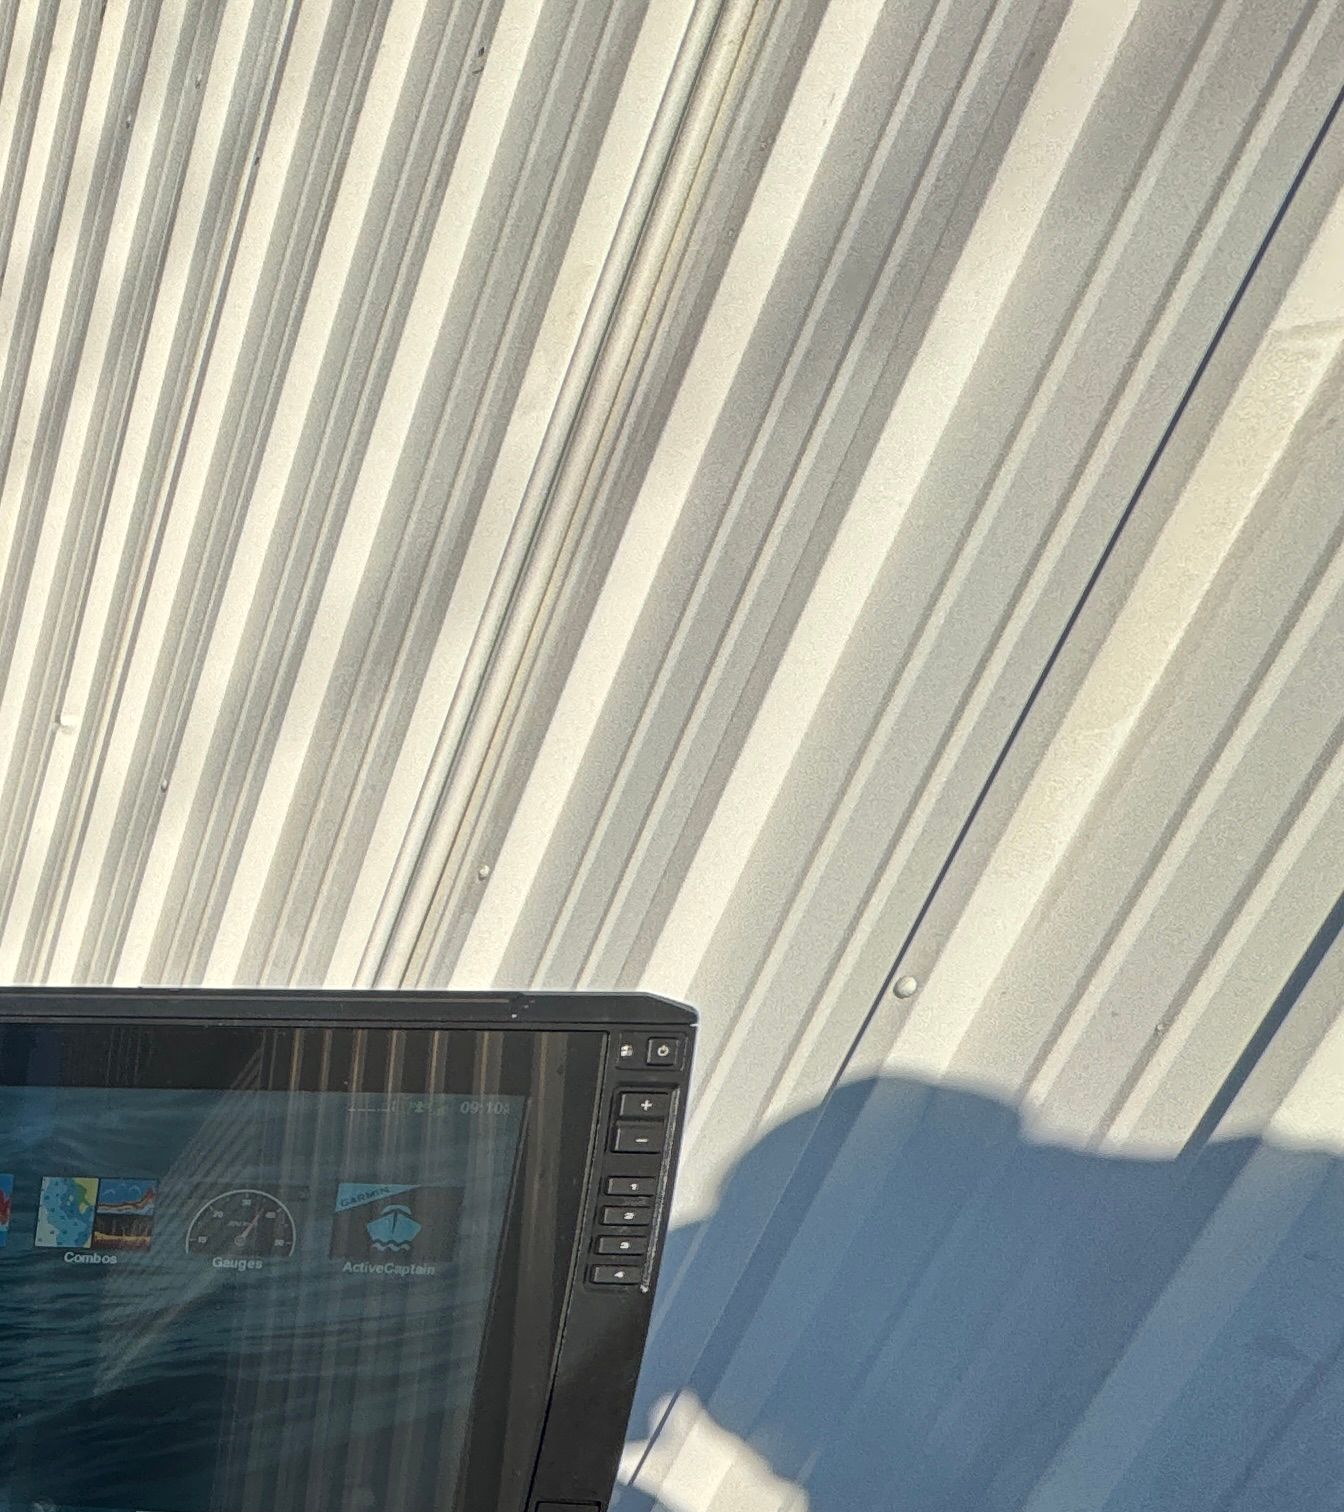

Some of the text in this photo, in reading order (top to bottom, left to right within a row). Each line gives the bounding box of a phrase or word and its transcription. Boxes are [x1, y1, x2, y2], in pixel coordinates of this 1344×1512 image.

[63, 1251, 118, 1266] Combos
[212, 1256, 263, 1273] Gauges
[342, 1260, 436, 1277] ActiveCaptain
